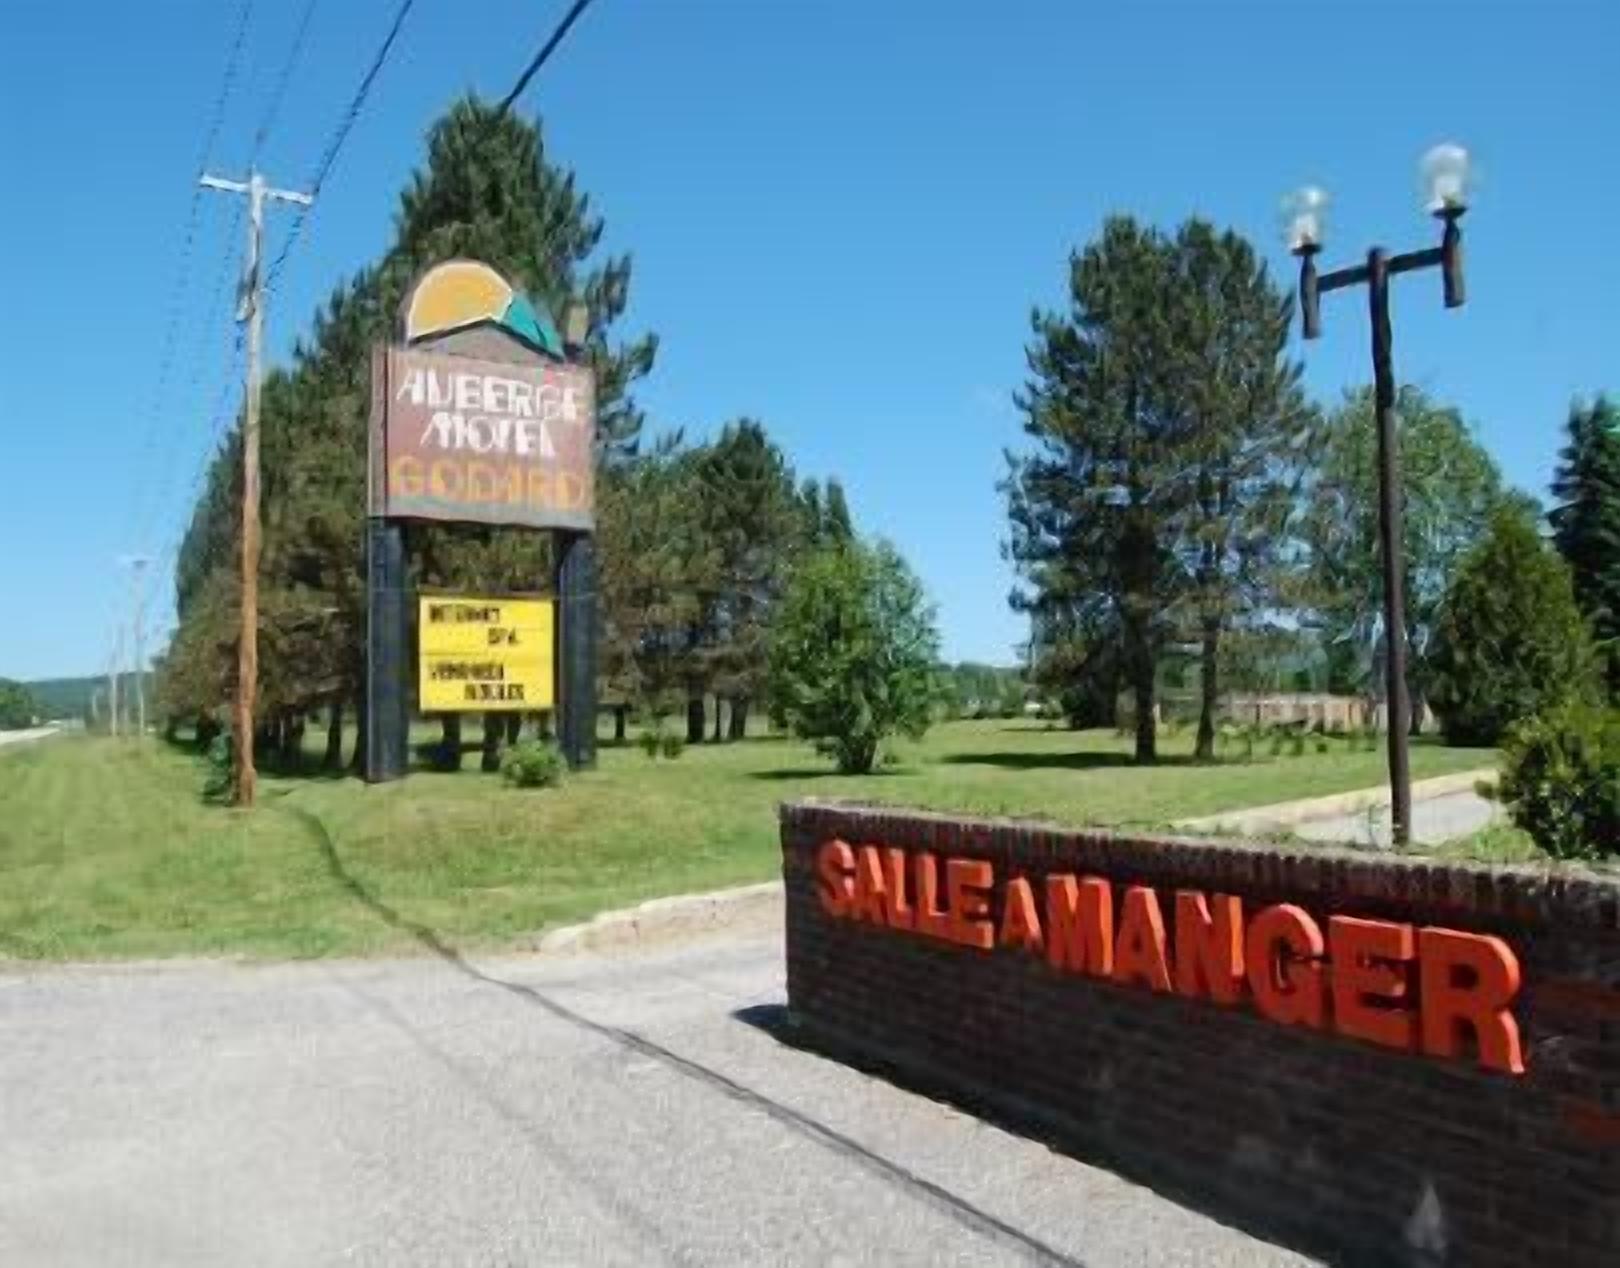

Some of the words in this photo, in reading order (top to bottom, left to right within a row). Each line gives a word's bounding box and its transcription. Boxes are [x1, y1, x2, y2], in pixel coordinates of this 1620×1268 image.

[396, 367, 584, 420] AUBERGE
[420, 411, 555, 458] MOTEL
[816, 838, 994, 949] SALLE
[1002, 878, 1042, 952] A
[1045, 873, 1525, 1075] MANGER
